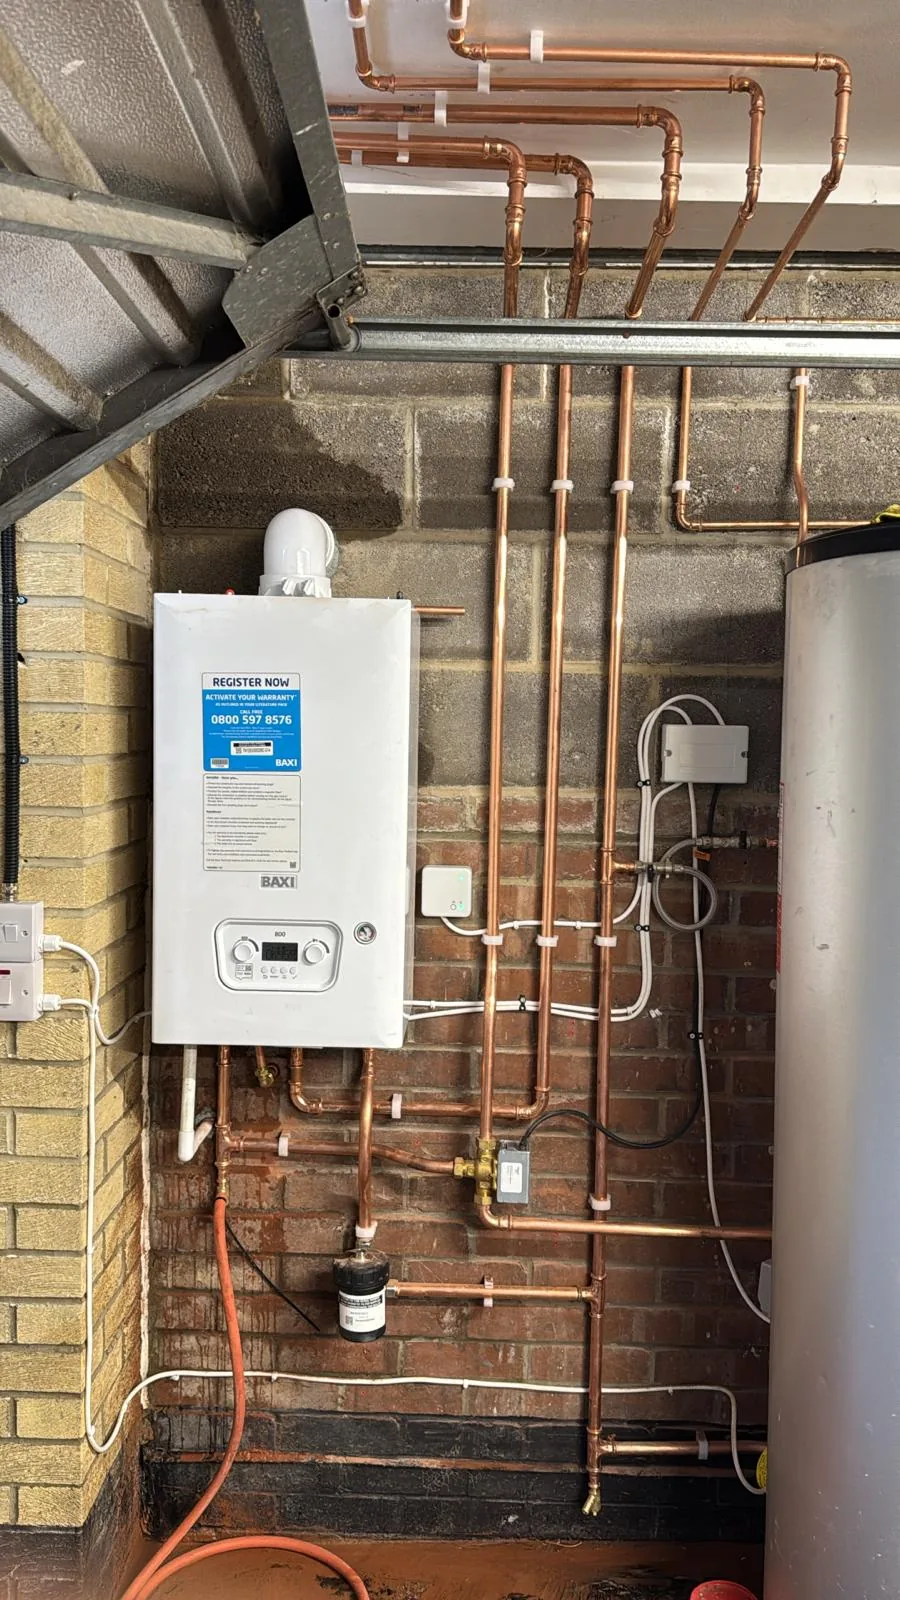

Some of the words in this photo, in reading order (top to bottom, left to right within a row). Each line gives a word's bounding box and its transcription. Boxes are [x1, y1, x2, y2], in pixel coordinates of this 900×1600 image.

[213, 677, 262, 687] REGISTER
[264, 677, 290, 687] NOW
[211, 715, 239, 725] 0800
[242, 715, 262, 725] 597
[265, 715, 292, 725] 8576
[275, 759, 298, 767] BAXI
[260, 876, 295, 888] BAXI
